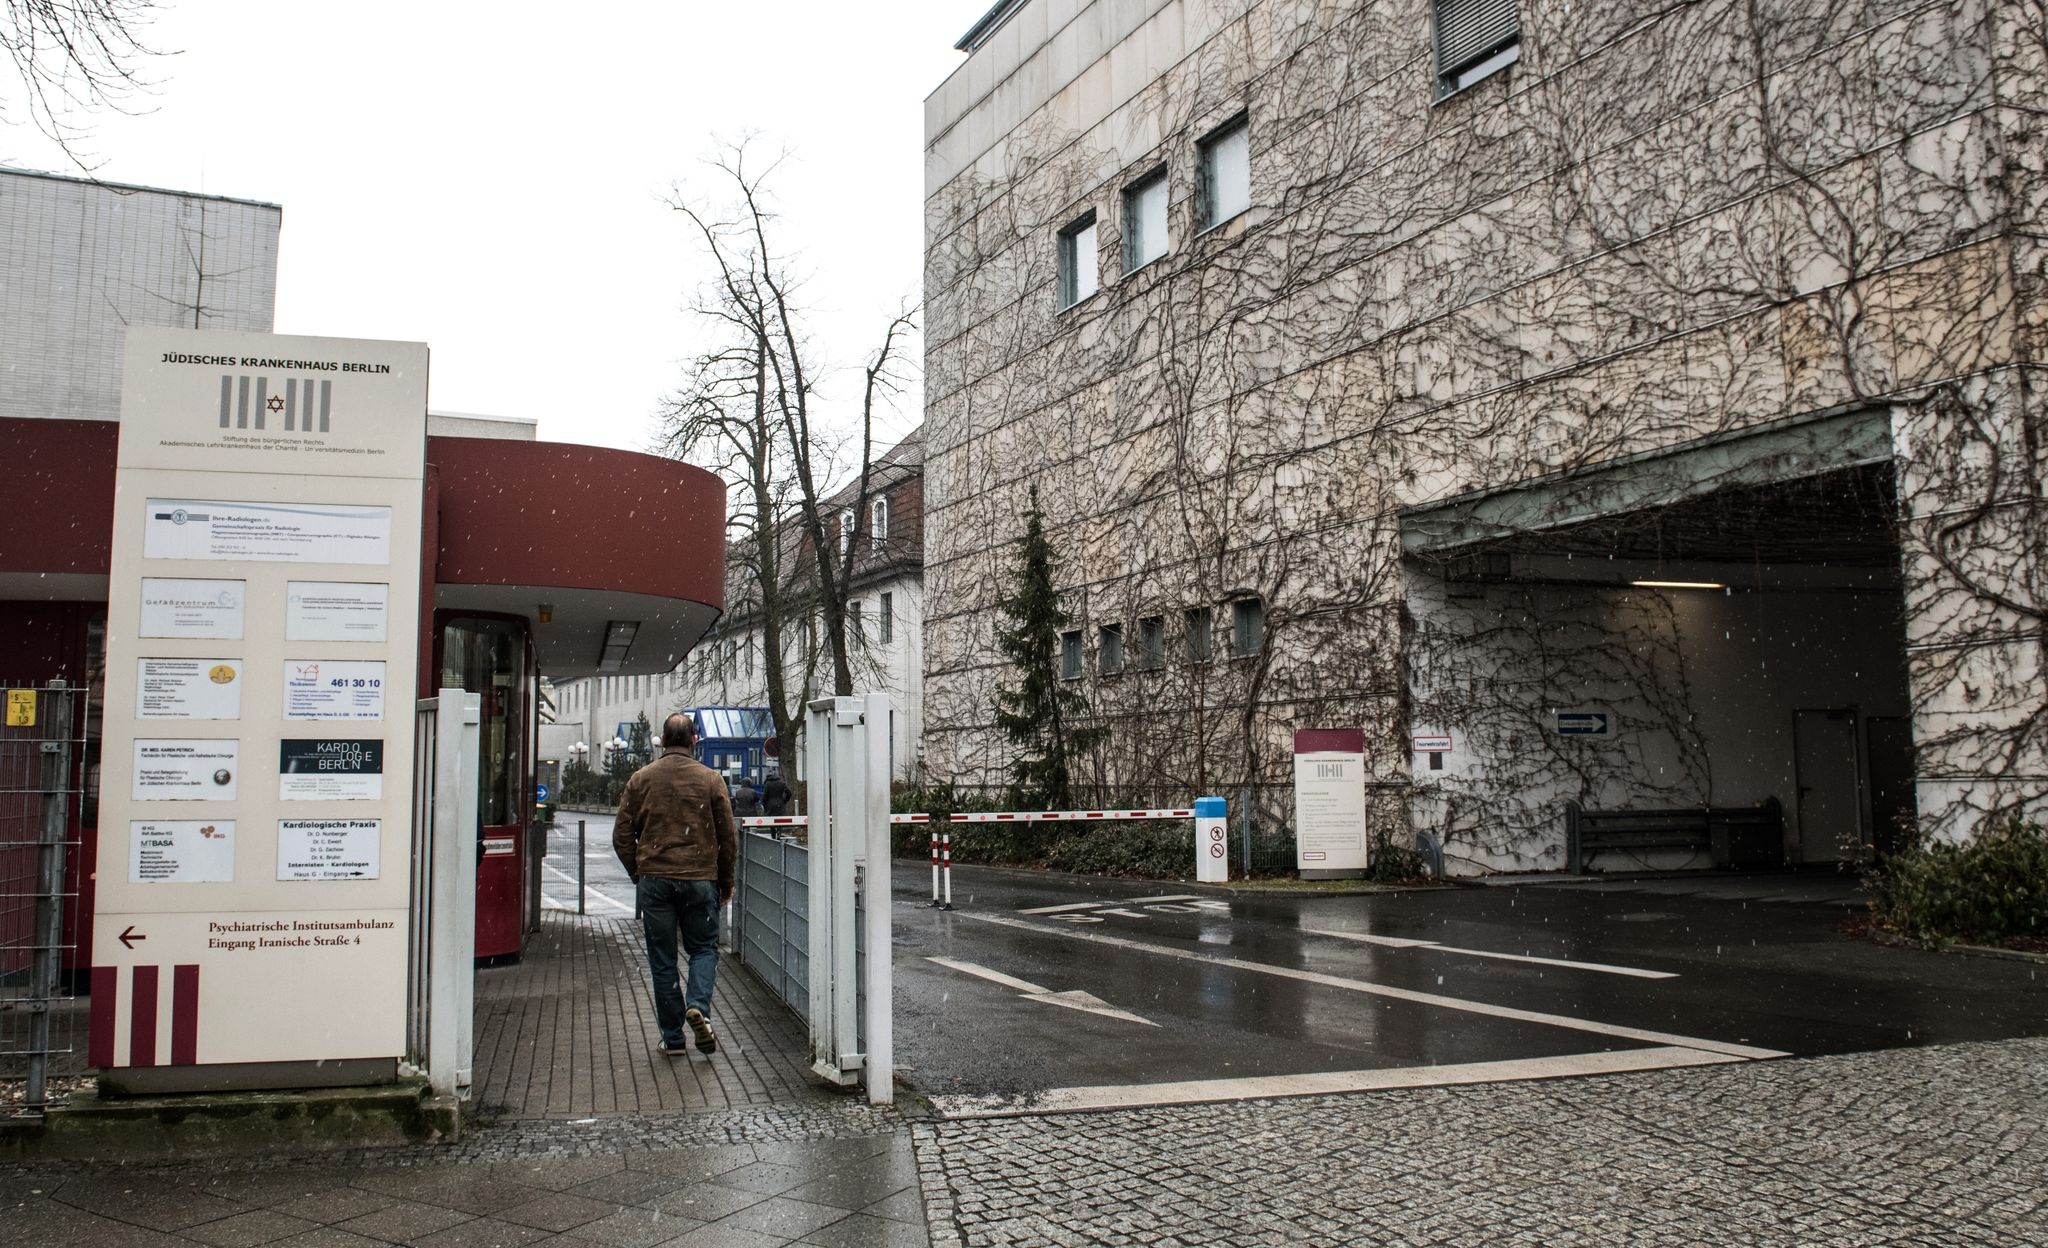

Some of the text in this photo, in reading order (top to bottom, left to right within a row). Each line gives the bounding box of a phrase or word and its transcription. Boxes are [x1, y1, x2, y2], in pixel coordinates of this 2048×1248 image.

[161, 352, 390, 374] JÜDISCHES KRANKENHAUS BERLIN
[222, 435, 248, 443] Stiftung
[159, 440, 205, 448] Akademisches
[206, 442, 261, 450] Lehrkrankenhaus
[304, 446, 365, 454] Unversitätsmedizin
[331, 678, 380, 688] 461 30 10
[317, 742, 360, 753] KARDO
[340, 751, 373, 761] LOGE
[318, 759, 360, 770] BERLN
[283, 821, 347, 829] Kardiologische
[209, 919, 394, 935] Psychiatrische Institutsambulanz
[208, 934, 361, 950] Eingang Iranische Straße 4
